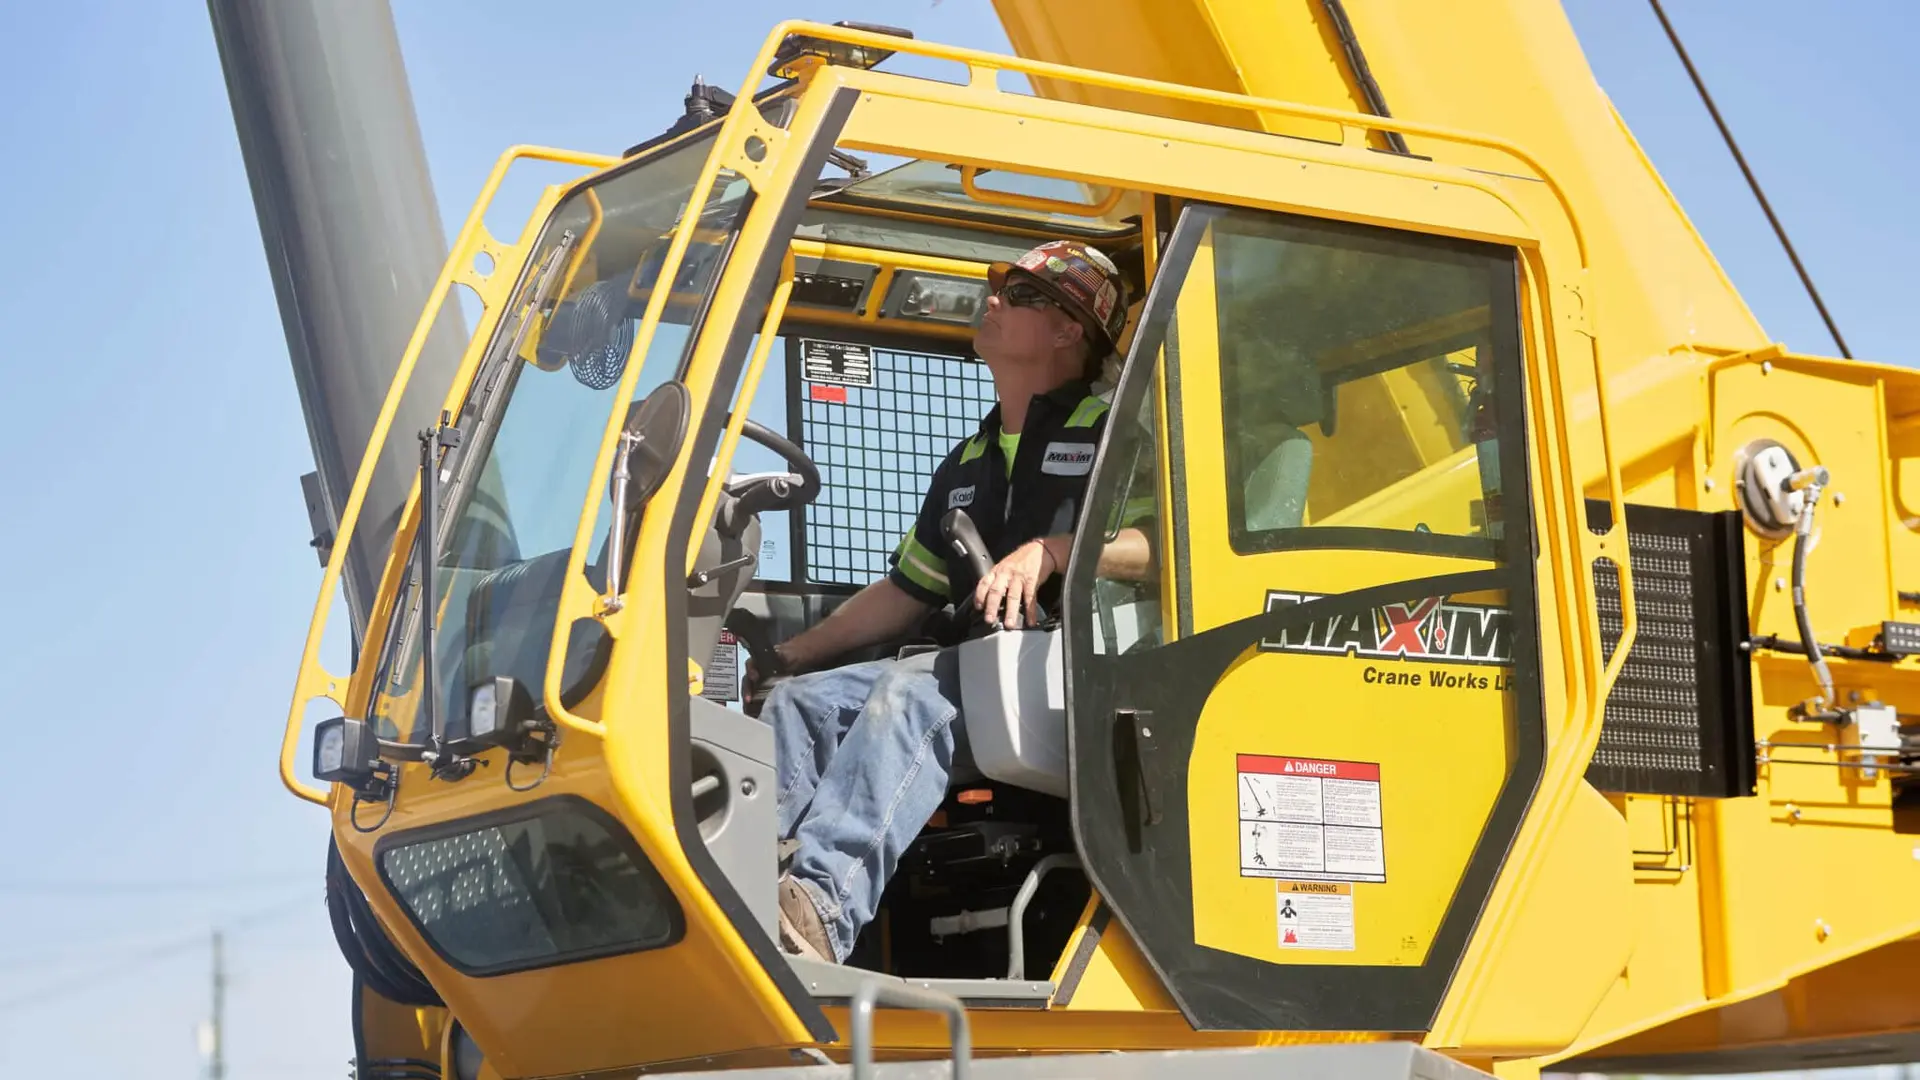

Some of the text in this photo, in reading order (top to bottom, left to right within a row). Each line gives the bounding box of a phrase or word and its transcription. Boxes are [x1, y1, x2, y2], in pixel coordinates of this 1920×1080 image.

[1045, 450, 1093, 464] MAXIM
[1260, 590, 1514, 664] MAXIM
[1363, 666, 1422, 686] Crane
[1429, 670, 1489, 690] Works
[1295, 761, 1337, 775] DANGER
[1299, 883, 1338, 893] WARNING
